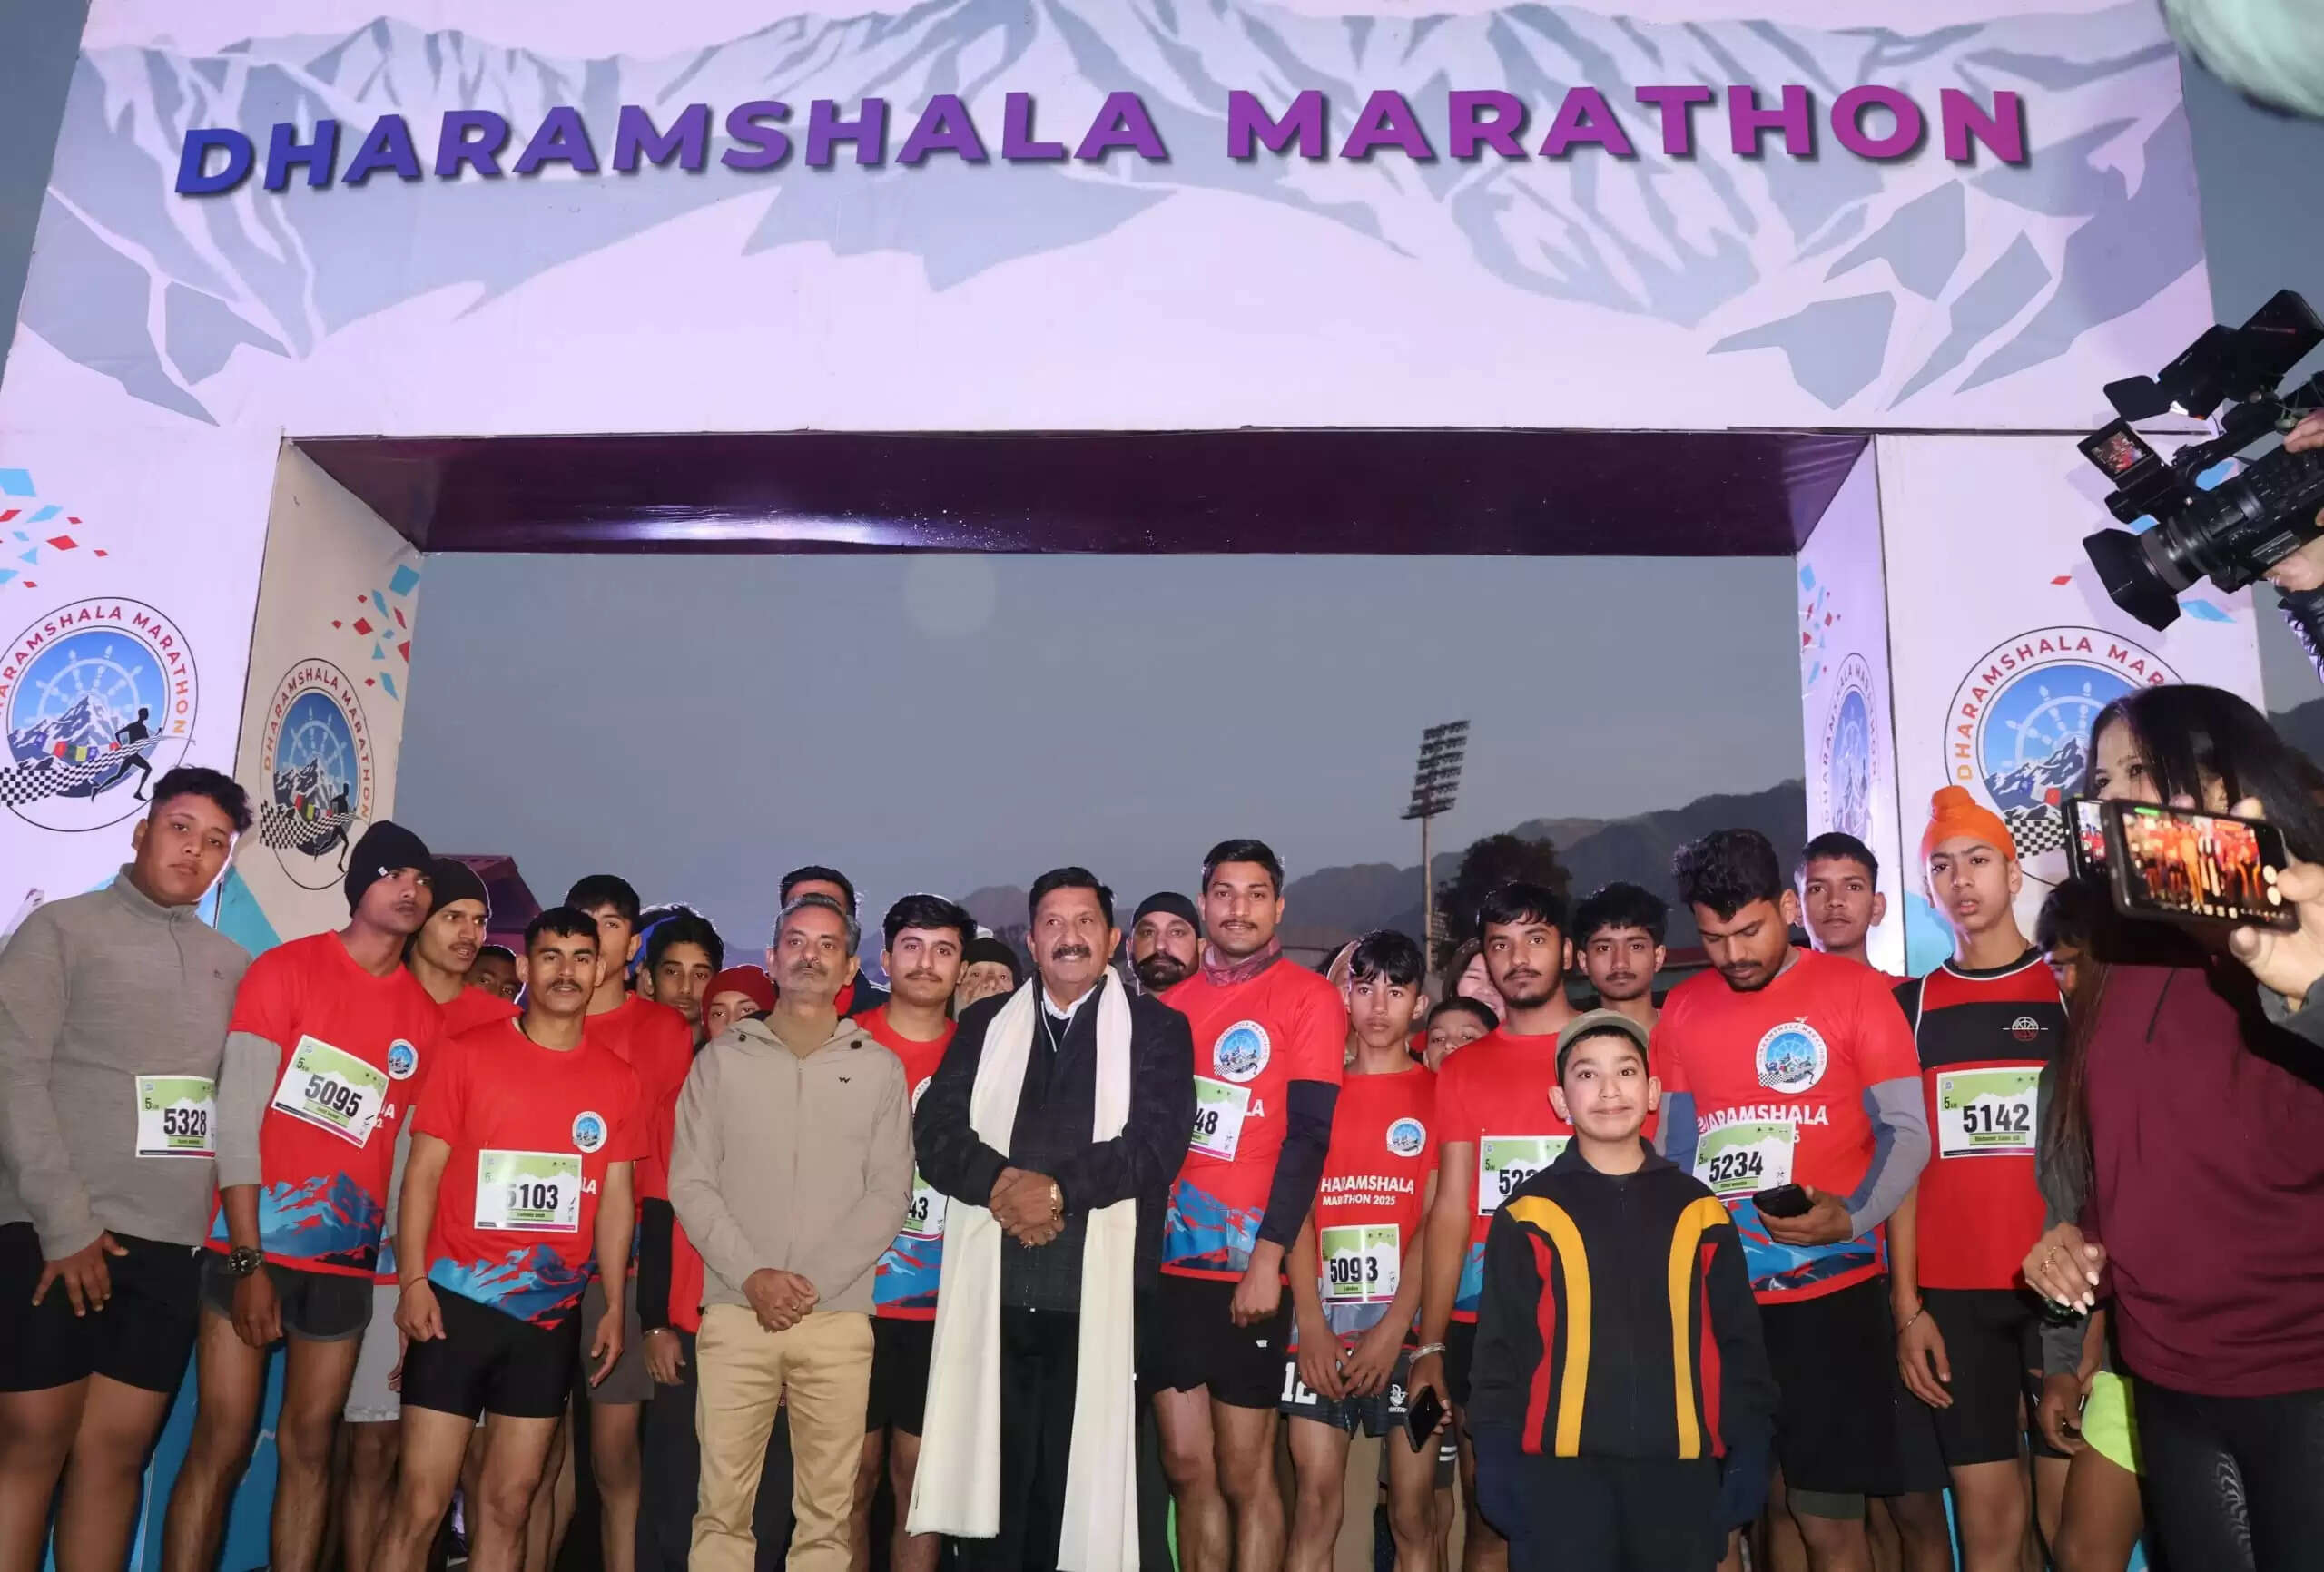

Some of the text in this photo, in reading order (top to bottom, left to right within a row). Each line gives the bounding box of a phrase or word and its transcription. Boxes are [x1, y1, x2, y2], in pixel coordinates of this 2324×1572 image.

[175, 84, 2028, 194] DHARAMSHALA MARATHON
[0, 605, 189, 734] ARAMSHALA MARATHON
[1955, 635, 2092, 781] DHARAMSHALA
[264, 667, 370, 819] DHARAMSHALA MARATHON
[304, 1074, 363, 1118] 5095
[163, 1108, 207, 1136] 5328
[1194, 1107, 1219, 1135] 48
[1963, 1103, 2030, 1134] 5142
[1499, 1169, 1540, 1194] 52
[1709, 1151, 1764, 1183] 5234
[1320, 1174, 1414, 1195] HARAMSHALA
[909, 1196, 929, 1222] 43
[1373, 1194, 1396, 1206] 2025
[1330, 1256, 1379, 1283] 5093
